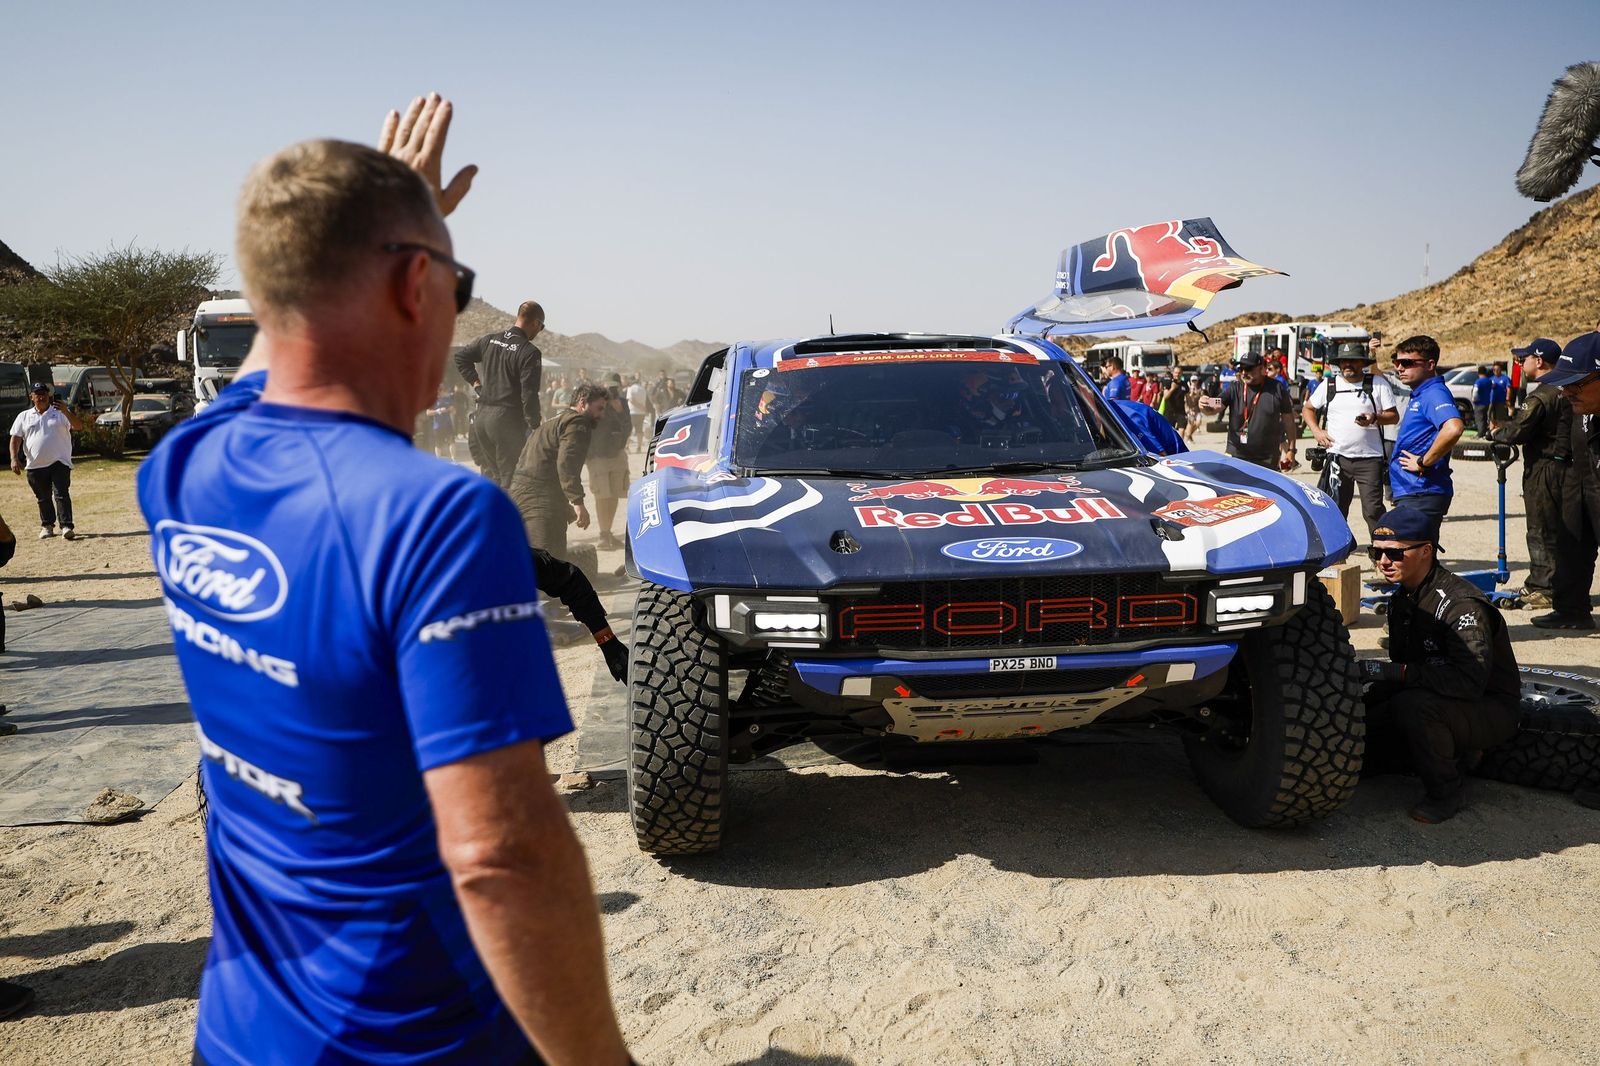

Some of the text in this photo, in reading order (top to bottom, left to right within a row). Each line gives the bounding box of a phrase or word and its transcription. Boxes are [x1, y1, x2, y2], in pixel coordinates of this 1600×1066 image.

[853, 497, 1128, 529] Red Bull
[971, 539, 1055, 559] Ford
[168, 533, 266, 610] Ford
[839, 592, 1198, 639] FORD
[993, 657, 1053, 670] PX25 BNO
[196, 728, 319, 825] PTOR
